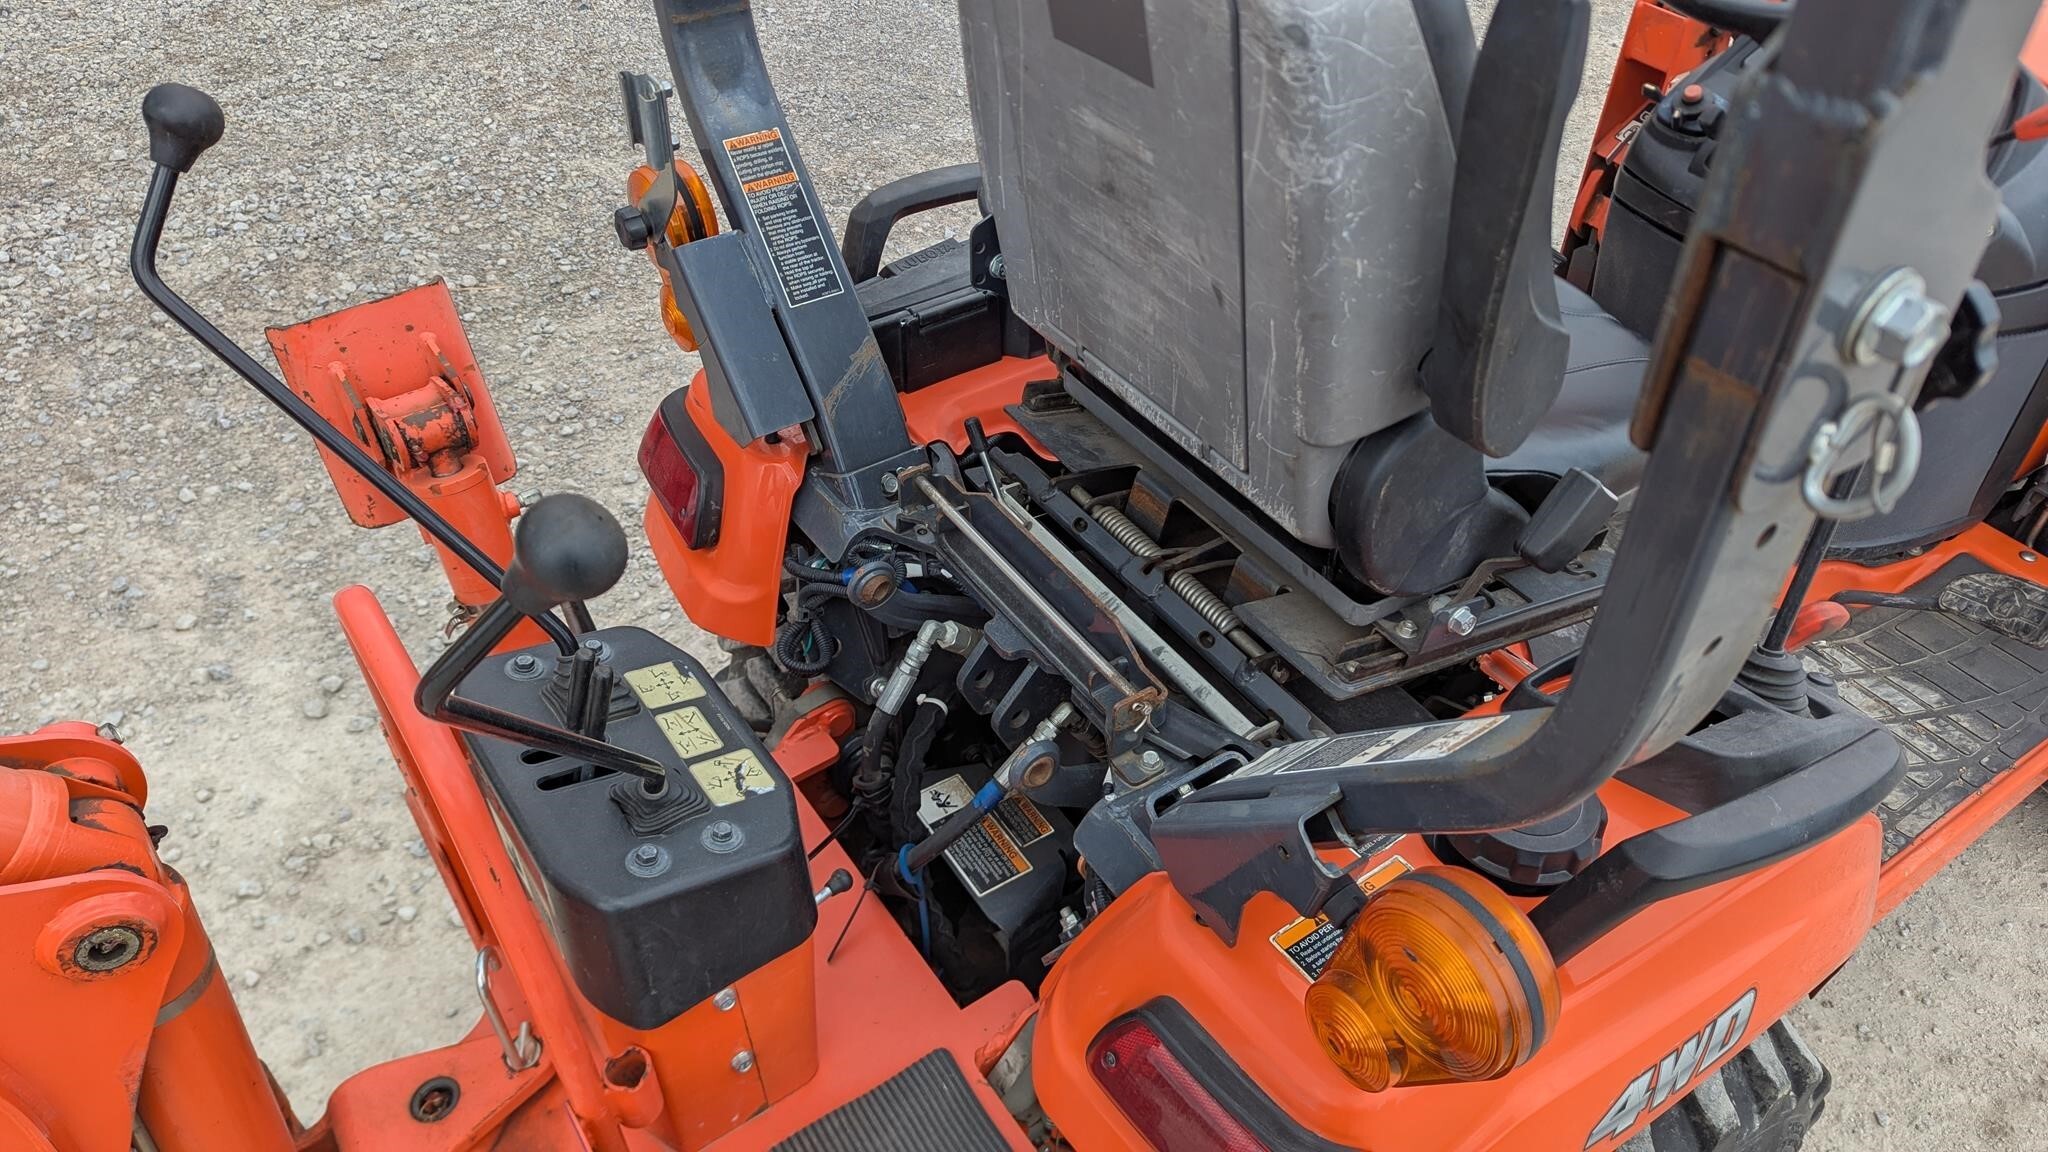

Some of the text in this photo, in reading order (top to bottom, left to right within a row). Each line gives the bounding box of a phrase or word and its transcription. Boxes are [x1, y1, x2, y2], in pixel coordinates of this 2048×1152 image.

[735, 130, 777, 146] WARNING
[753, 173, 794, 189] WARNING
[749, 195, 768, 203] INJURY
[754, 188, 771, 196] AVOID
[751, 201, 768, 209] WHEN
[767, 195, 789, 205] RAISING
[753, 204, 777, 214] FOLDING
[894, 243, 955, 272] KUBOTA
[807, 266, 825, 274] securely
[1020, 801, 1049, 834] WARNING
[985, 820, 1017, 859] WARNING
[1357, 832, 1385, 854] DIESEL FUEL
[1288, 944, 1301, 956] TO
[1298, 931, 1320, 949] AVOID
[1300, 946, 1313, 957] Read
[1311, 940, 1322, 950] and
[1305, 950, 1321, 963] Before
[1319, 939, 1337, 954] starting
[1314, 956, 1325, 966] safe
[1585, 988, 1757, 1150] 4WD
